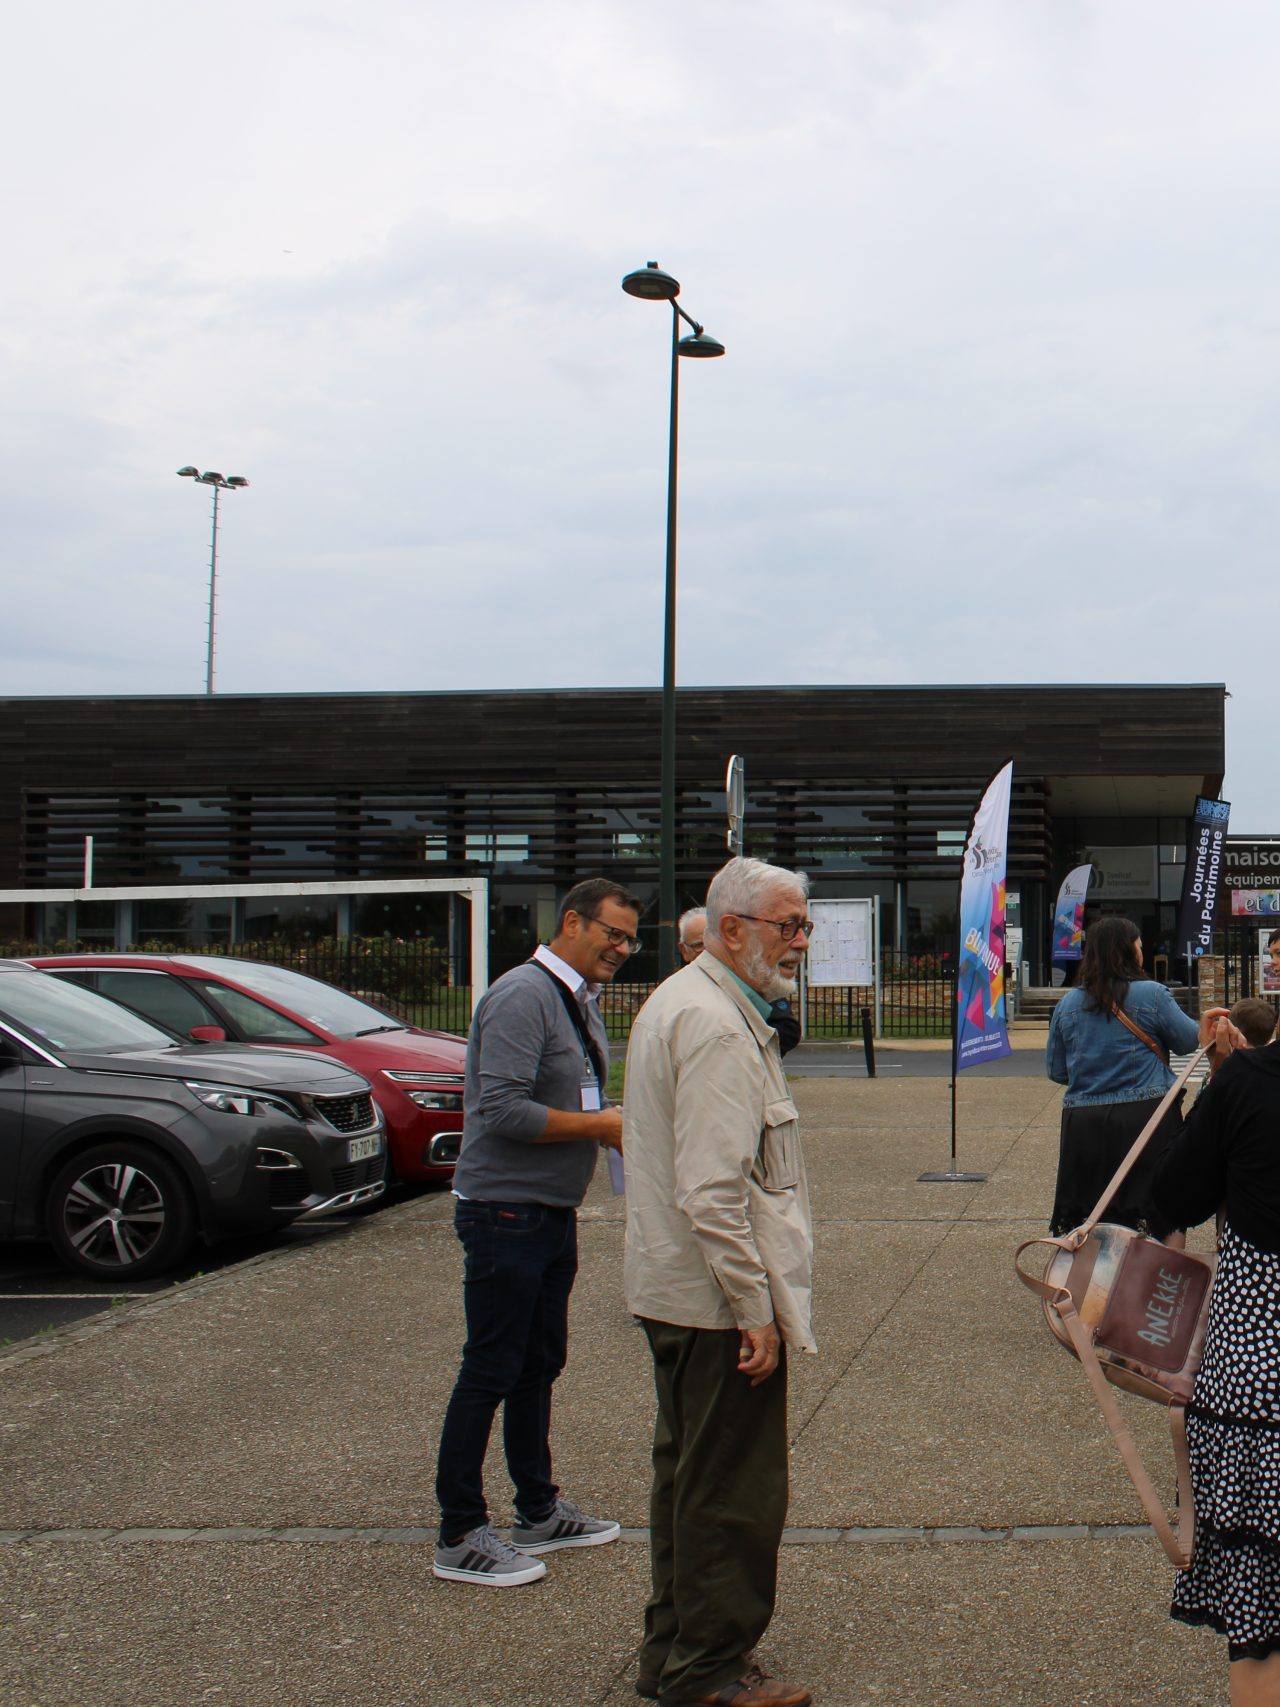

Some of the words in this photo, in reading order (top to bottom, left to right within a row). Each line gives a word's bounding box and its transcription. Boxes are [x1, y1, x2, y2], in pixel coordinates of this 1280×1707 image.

[1190, 828, 1210, 903] Journées
[1201, 830, 1223, 920] Patrimoine
[1244, 894, 1264, 912] et
[1198, 925, 1211, 945] du
[1137, 1268, 1182, 1347] ANEKKE
